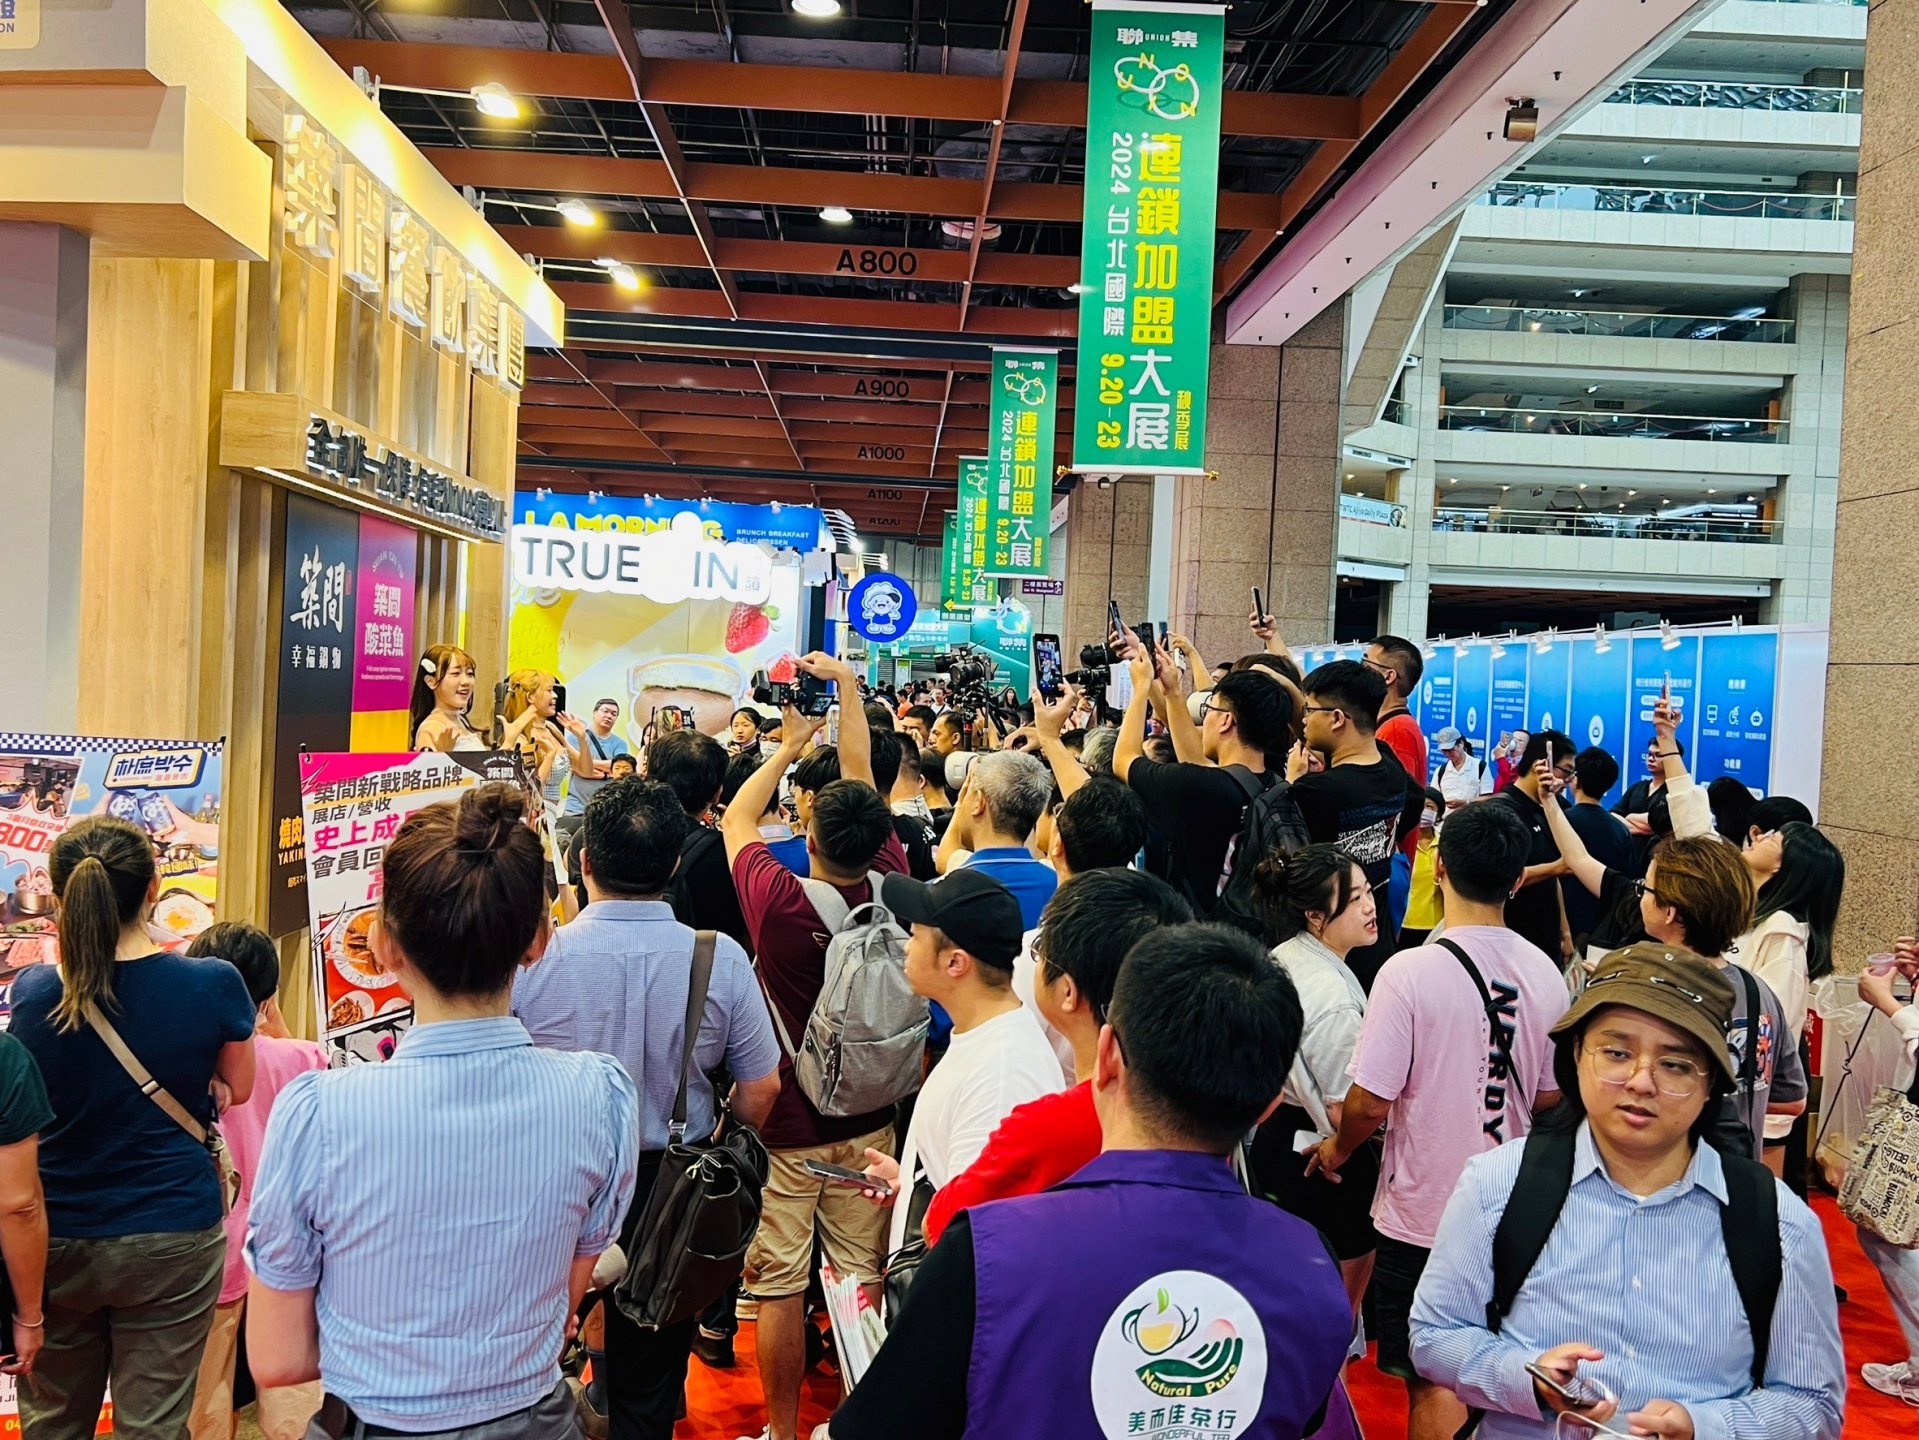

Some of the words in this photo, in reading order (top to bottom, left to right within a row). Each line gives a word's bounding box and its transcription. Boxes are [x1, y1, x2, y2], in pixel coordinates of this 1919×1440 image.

[1144, 33, 1171, 42] UNION
[1110, 132, 1134, 195] 2024
[836, 249, 917, 276] A800
[1103, 205, 1130, 336] 台北國際
[1125, 132, 1183, 450] 連鎖加盟大展
[854, 379, 910, 398] A900
[1001, 410, 1014, 441] 2024
[858, 446, 905, 460] A1000
[868, 489, 903, 501] A1100
[1010, 410, 1039, 567] 連鎖加盟大展
[736, 528, 767, 536] BRUNCH
[768, 530, 810, 538] BREAKFAST
[869, 518, 901, 526] A1200
[520, 536, 641, 583] TRUE
[289, 544, 346, 634] 築間
[374, 582, 402, 619] 築間
[364, 622, 405, 657] 酸菜魚
[291, 644, 343, 671] 幸福鍋物
[313, 765, 463, 804] 築間新戰略品牌
[311, 796, 392, 825] 展店/營收
[1483, 978, 1518, 1145] NERDY
[1141, 1368, 1192, 1397] Natural
[1204, 1363, 1238, 1394] Pure
[1127, 1403, 1238, 1433] 美而佳茶行
